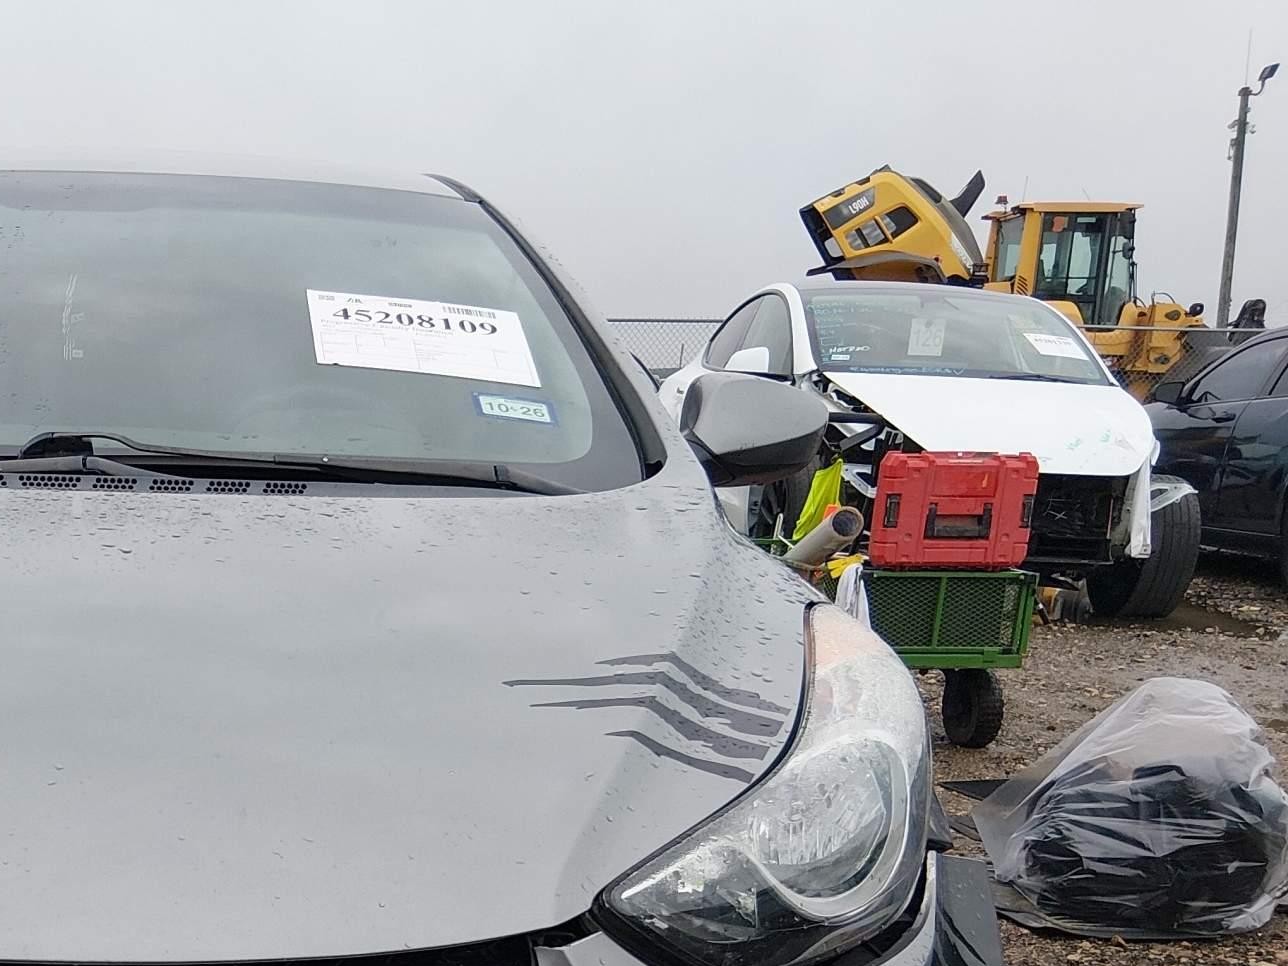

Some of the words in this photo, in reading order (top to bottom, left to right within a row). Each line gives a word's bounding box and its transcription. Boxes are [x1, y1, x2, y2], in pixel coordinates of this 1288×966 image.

[848, 196, 869, 214] L90H
[332, 308, 498, 336] 45208109
[913, 328, 942, 347] 126
